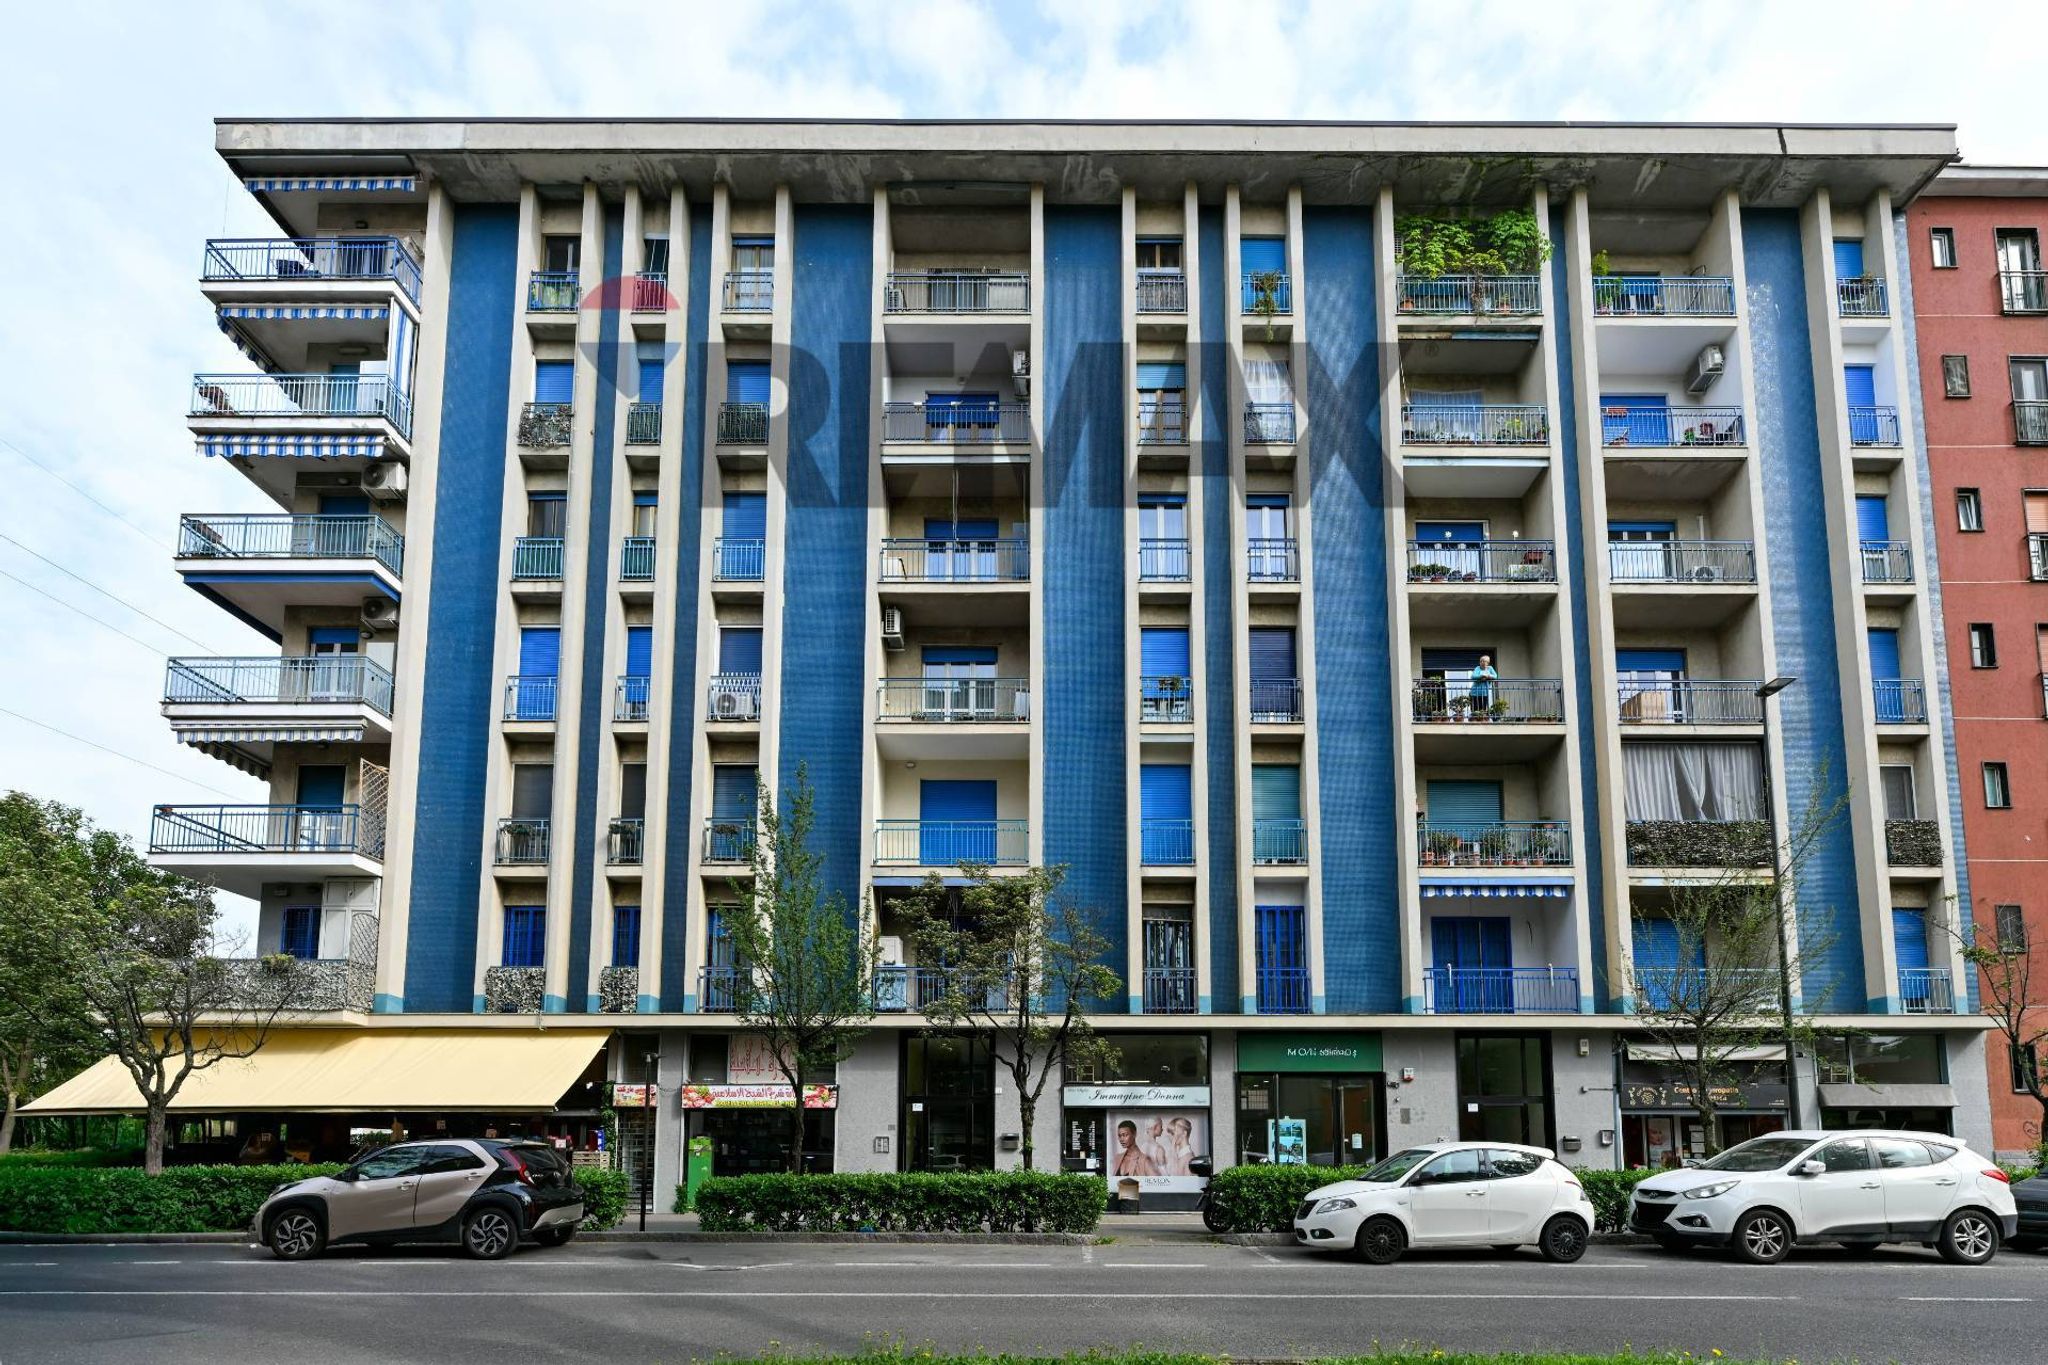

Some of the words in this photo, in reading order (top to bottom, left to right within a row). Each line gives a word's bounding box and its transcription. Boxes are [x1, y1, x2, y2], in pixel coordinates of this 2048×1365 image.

[1674, 1086, 1697, 1094] Cento
[1088, 1089, 1145, 1105] Immagine
[1145, 1088, 1185, 1101] Donna
